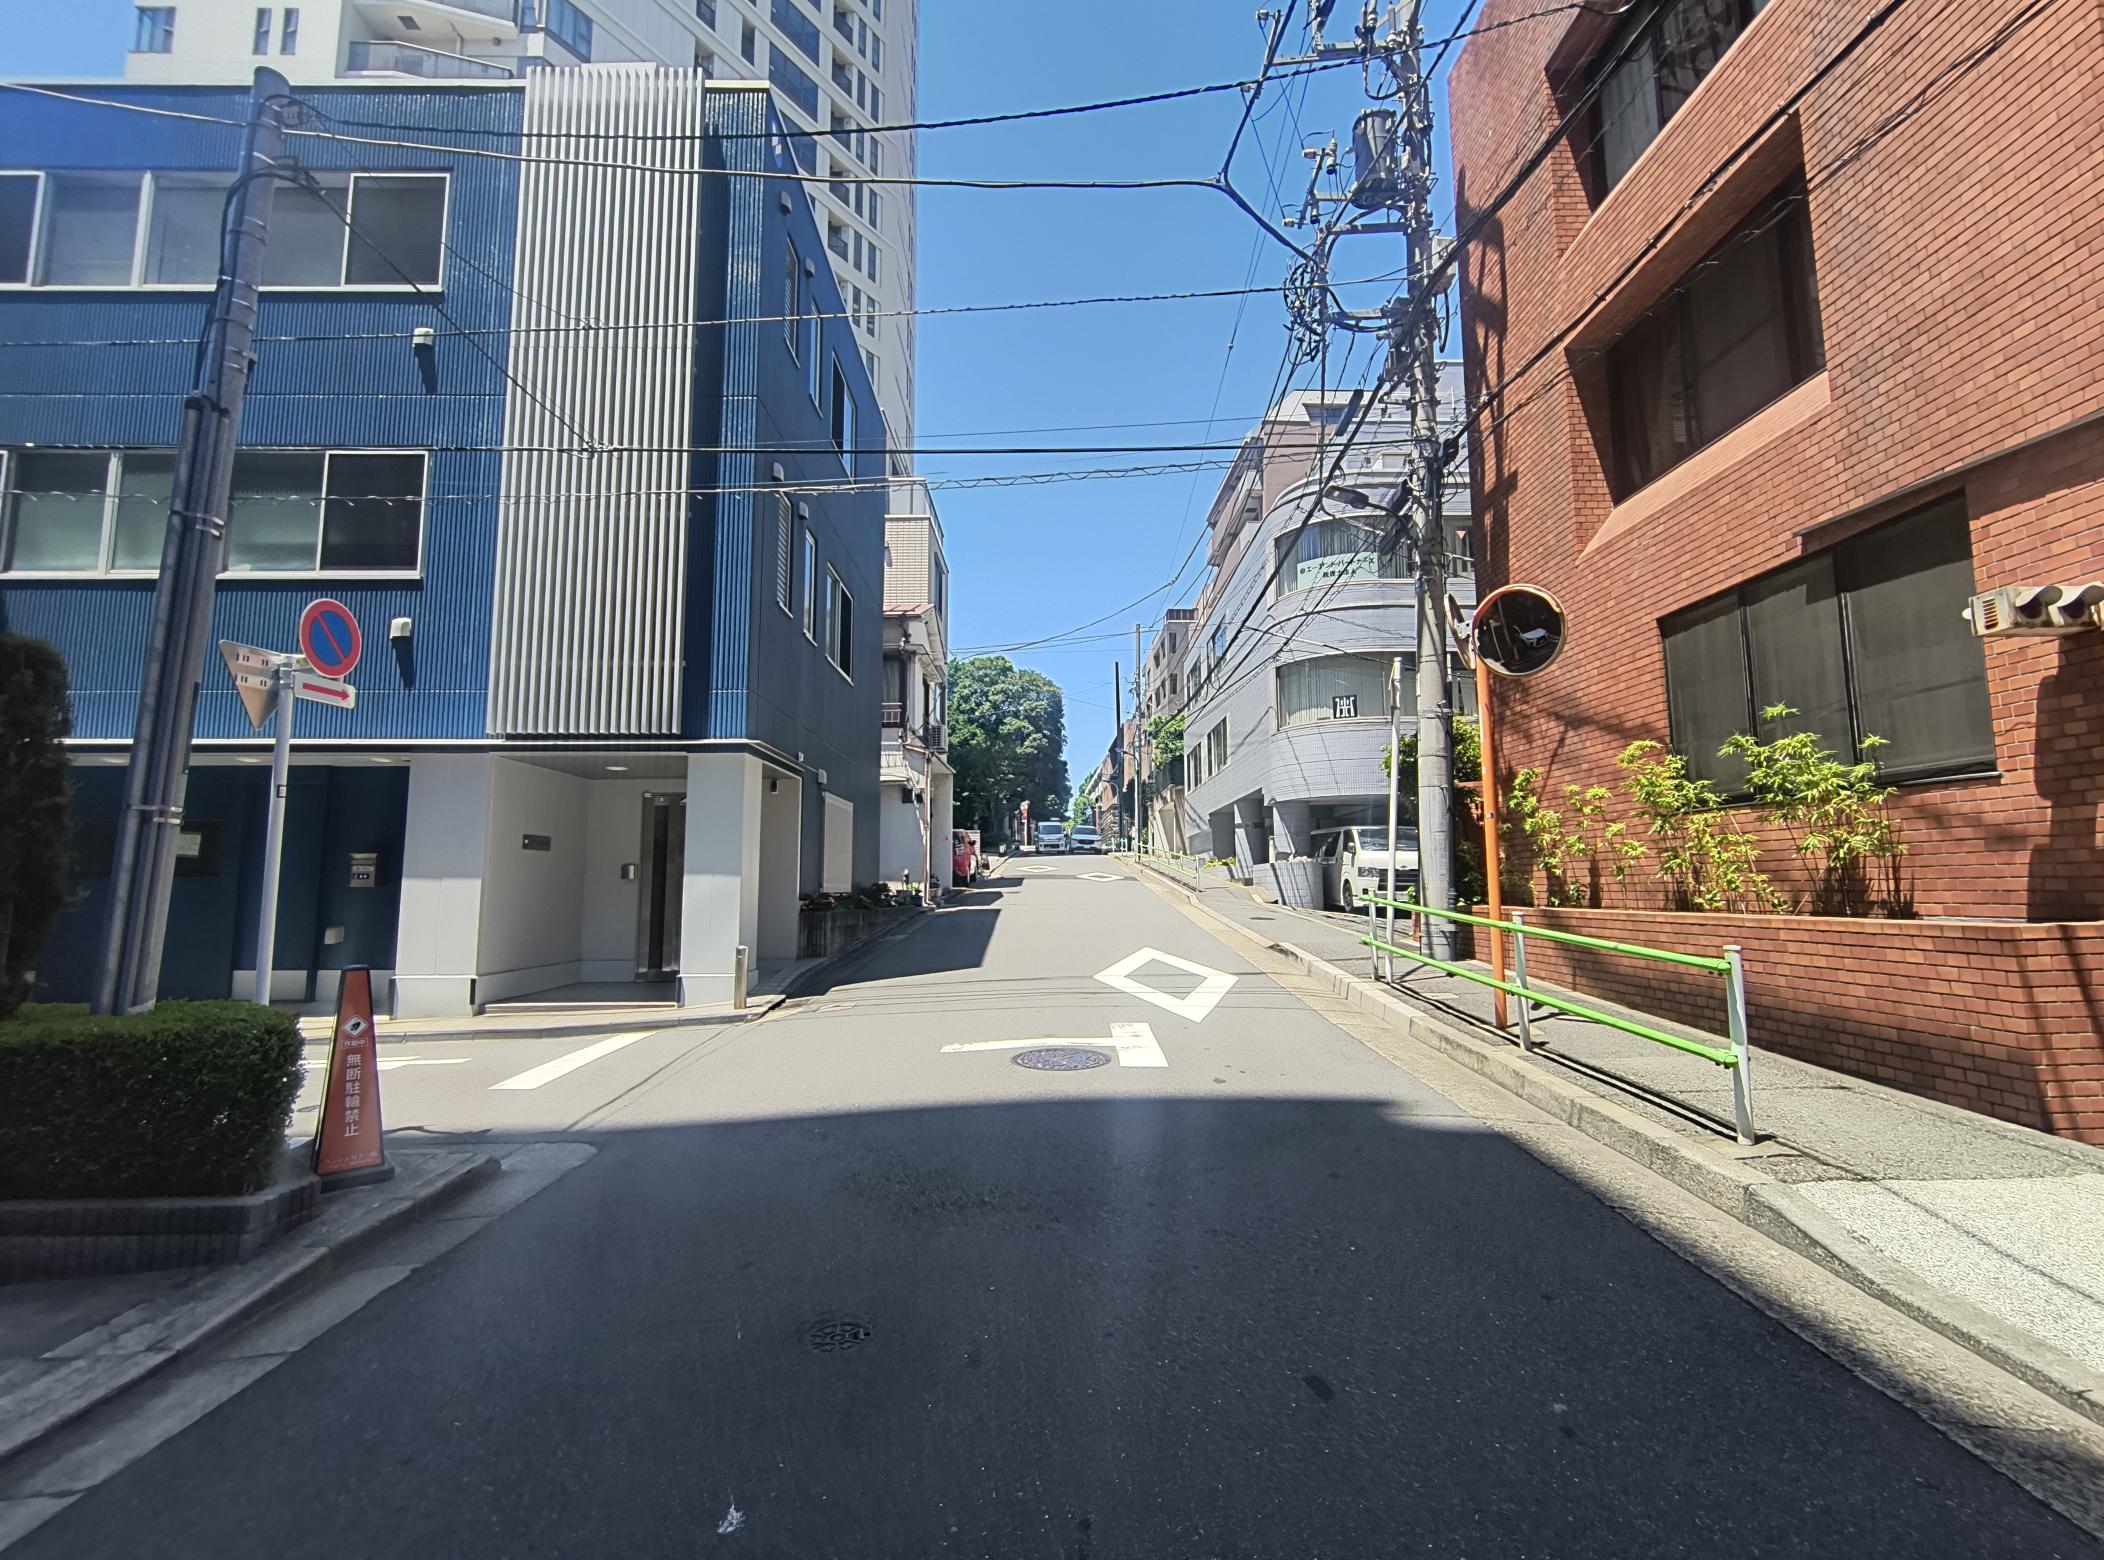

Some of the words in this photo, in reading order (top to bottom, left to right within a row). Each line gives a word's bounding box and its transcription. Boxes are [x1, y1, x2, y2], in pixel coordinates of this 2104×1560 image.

[344, 1054, 362, 1137] 無断駐輪禁止
